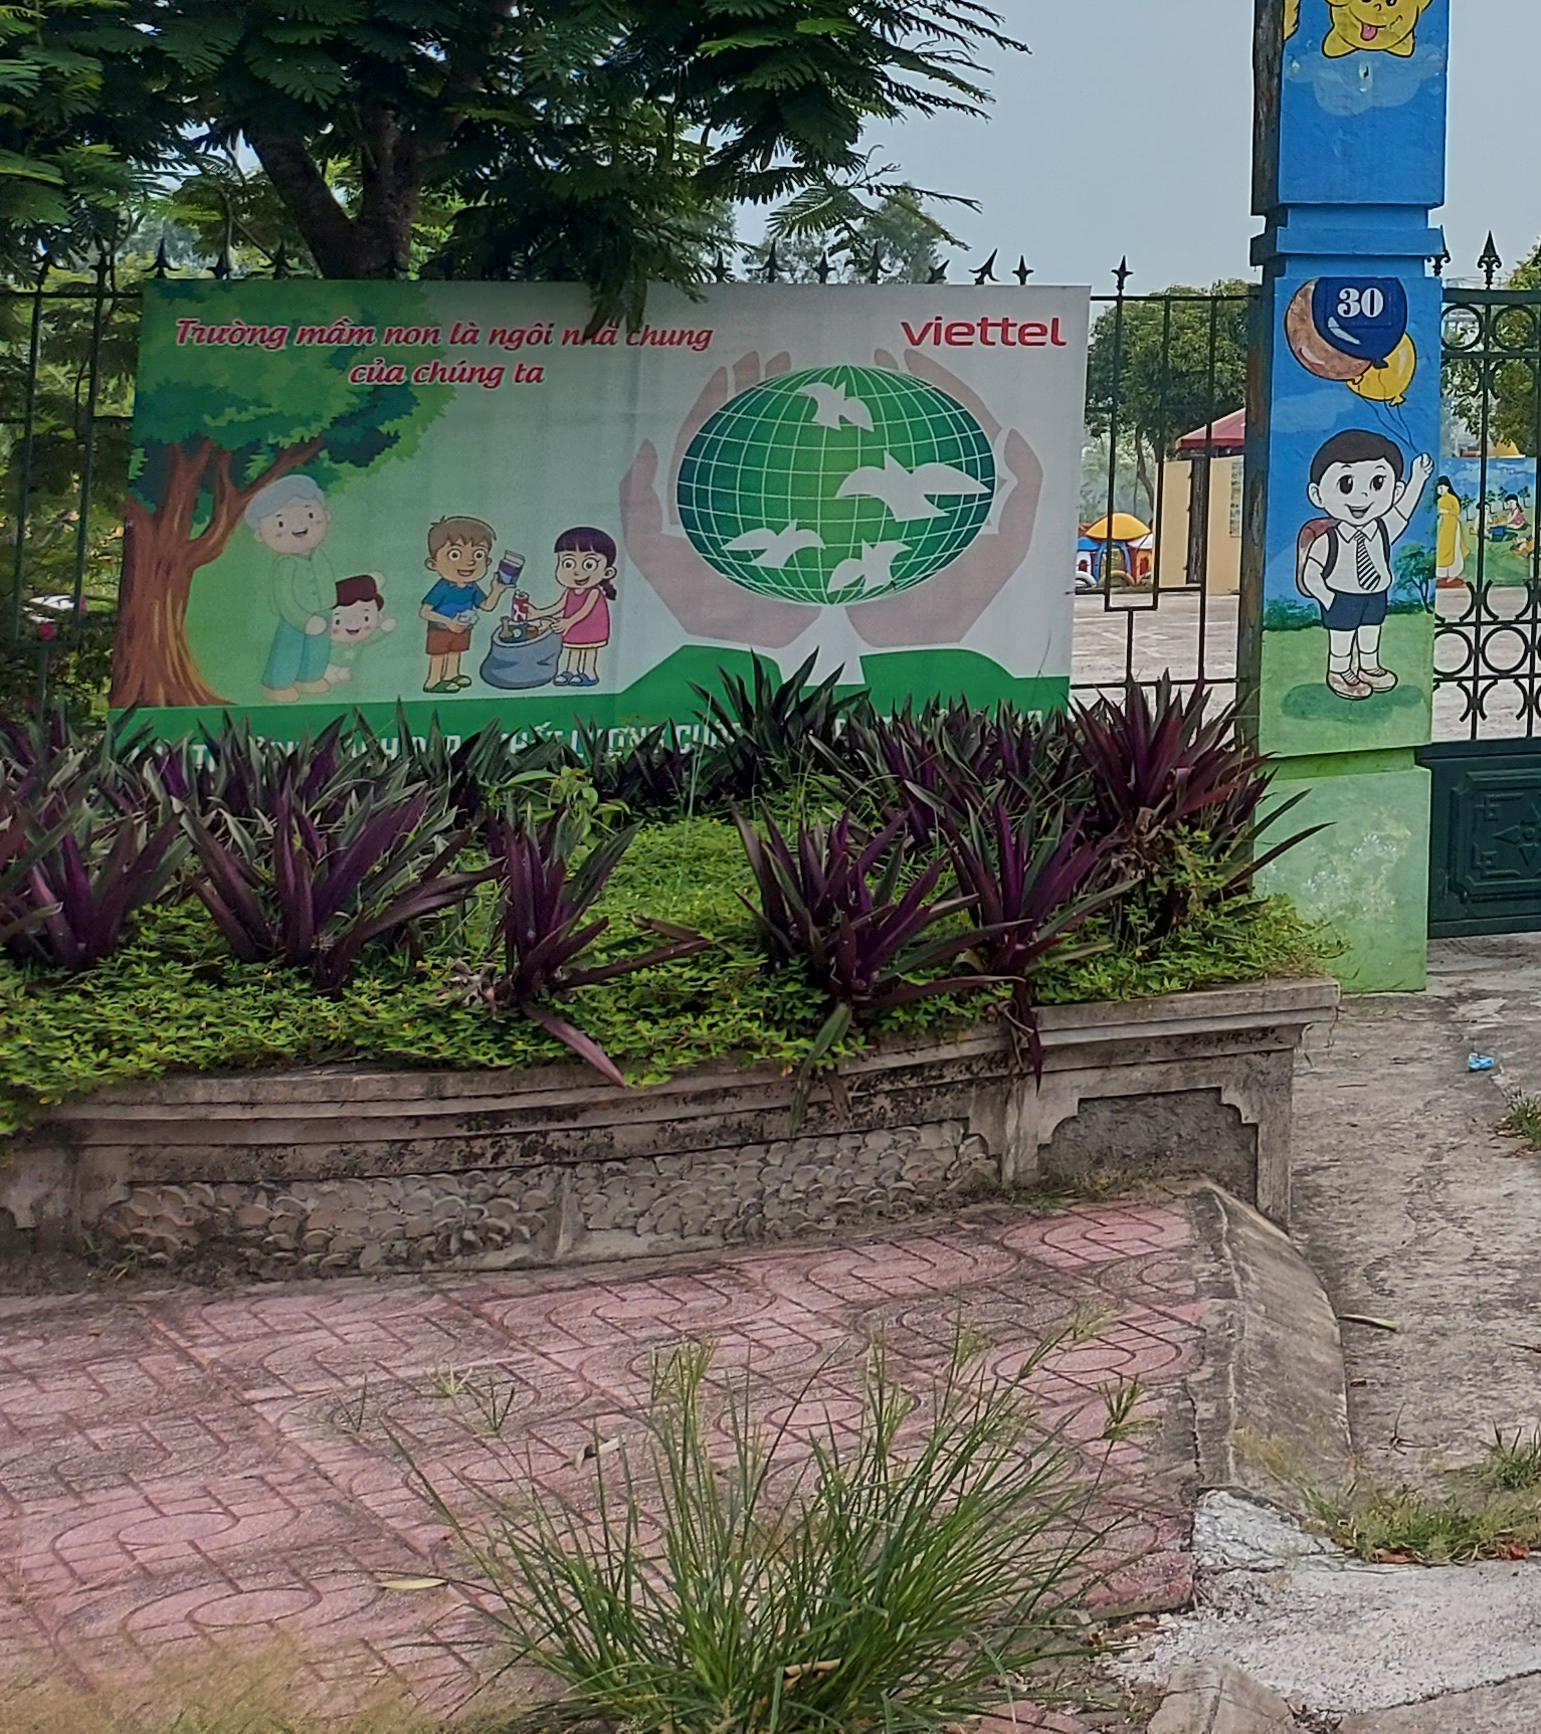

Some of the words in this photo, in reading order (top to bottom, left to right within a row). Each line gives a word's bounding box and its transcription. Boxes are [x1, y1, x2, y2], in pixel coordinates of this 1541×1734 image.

[1337, 287, 1384, 318] 30
[176, 318, 289, 350] Trường
[295, 317, 376, 346] mầm
[382, 325, 441, 346] non
[449, 322, 480, 346] là
[488, 322, 554, 351] ngôi
[626, 324, 714, 352] chung
[900, 316, 1067, 347] viettel
[348, 358, 406, 384] của
[412, 359, 505, 389] chúng
[513, 362, 545, 384] ta
